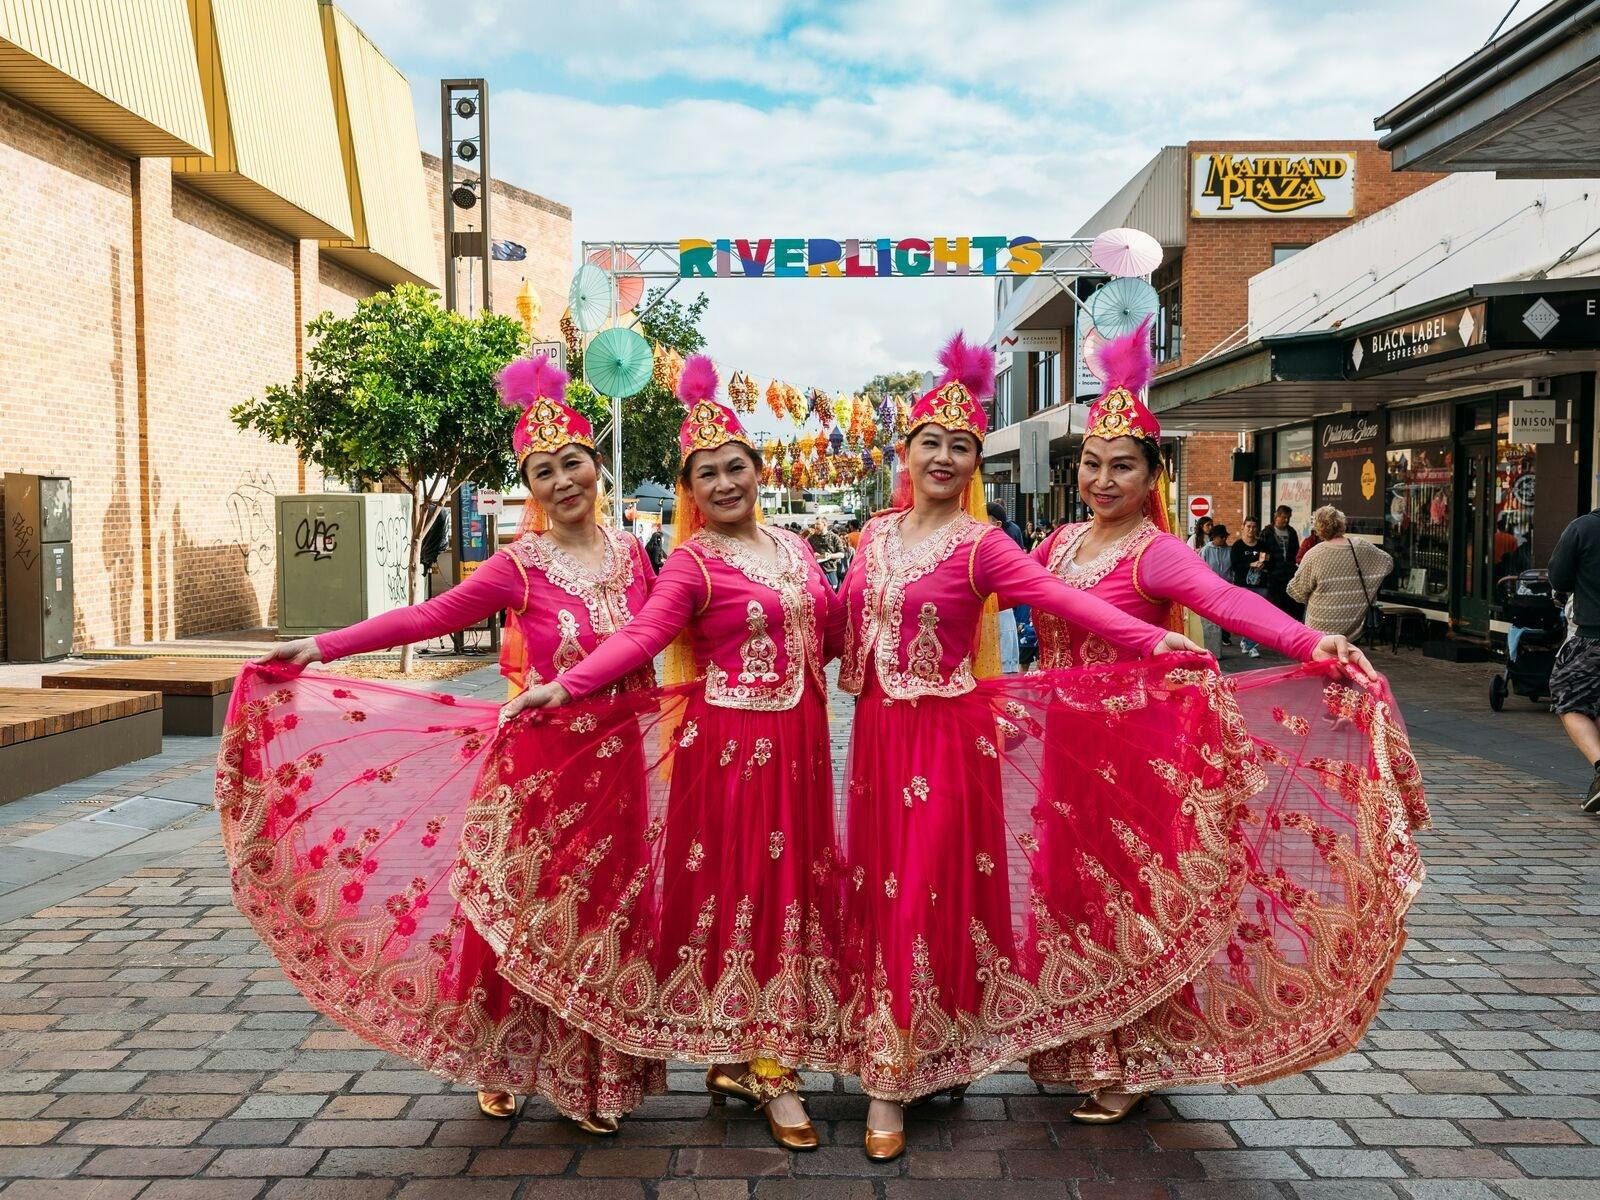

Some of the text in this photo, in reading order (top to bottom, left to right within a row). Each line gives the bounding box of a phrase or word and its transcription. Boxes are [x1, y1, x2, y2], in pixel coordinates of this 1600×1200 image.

[1202, 153, 1348, 196] MAITLAND
[1217, 177, 1325, 211] PLAZA
[679, 236, 1043, 278] RIVERLIGHTS
[1372, 317, 1447, 354] BLACK LABEL
[1387, 343, 1429, 362] ESPRESSO
[1354, 419, 1378, 443] Shoes
[1513, 417, 1555, 427] UNISON
[1322, 483, 1343, 495] BOBUX
